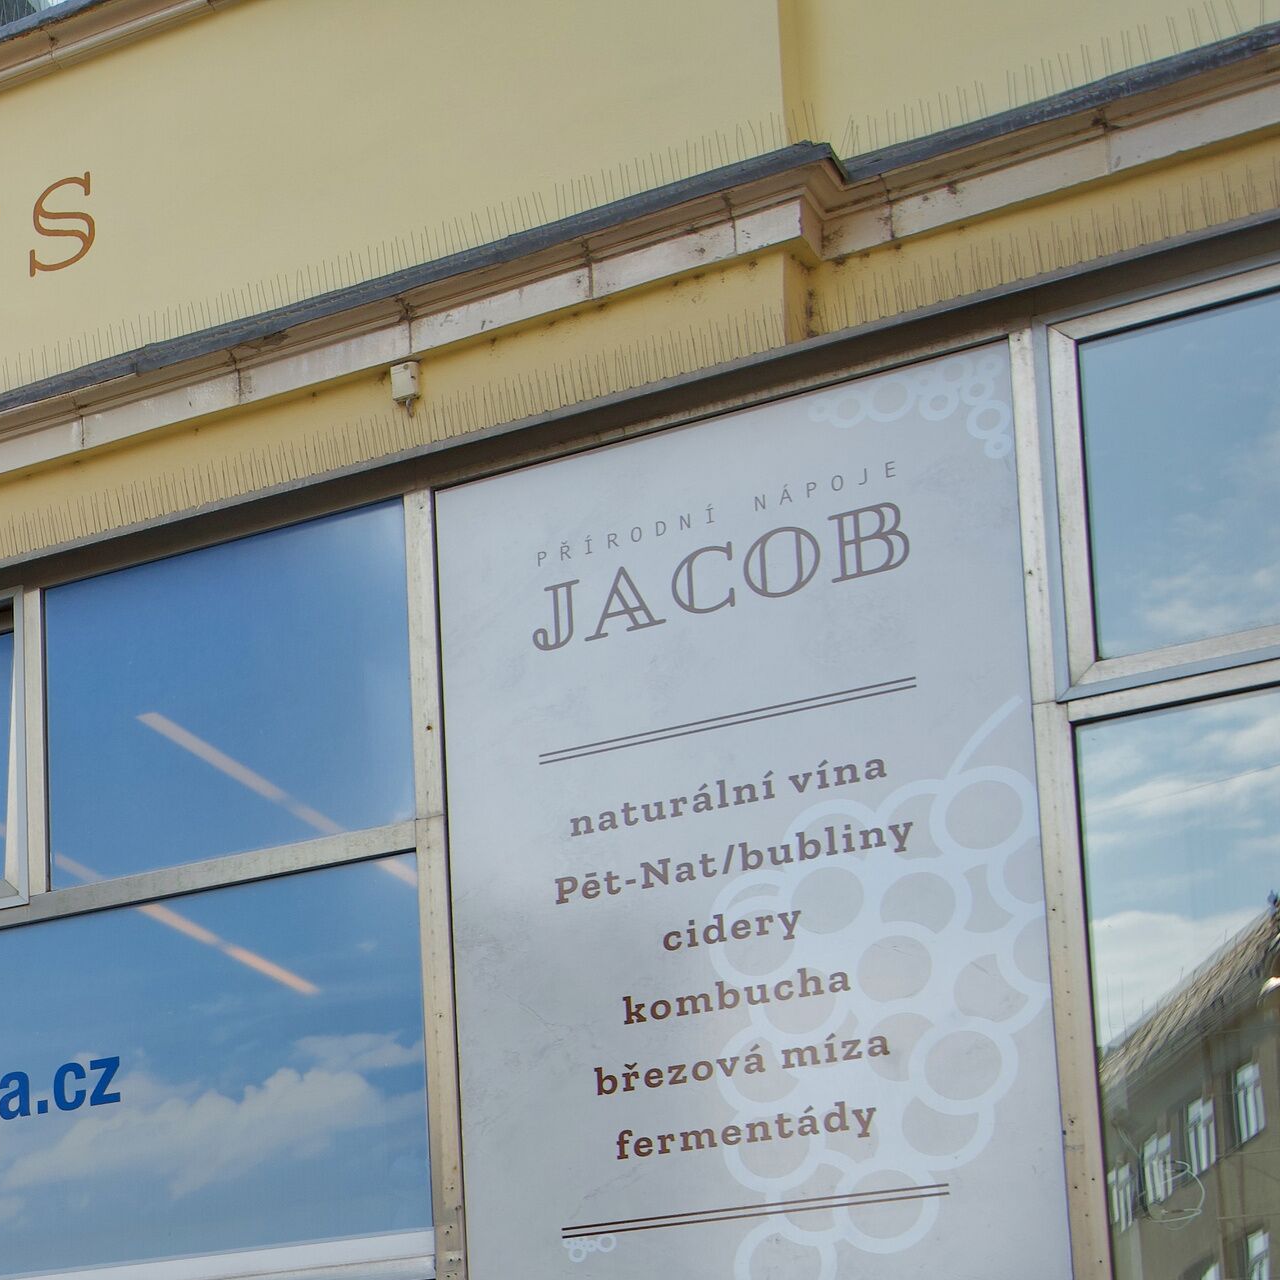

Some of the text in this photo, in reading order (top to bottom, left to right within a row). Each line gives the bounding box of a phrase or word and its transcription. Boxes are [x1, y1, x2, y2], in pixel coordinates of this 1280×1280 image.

[536, 461, 897, 567] PŘÍRODNÍ NÁPOJE
[532, 502, 910, 651] JACOB
[570, 757, 887, 837] naturální vína
[663, 910, 801, 951] cidery
[622, 967, 851, 1025] kombucha
[594, 1032, 890, 1095] březová míza
[616, 1101, 876, 1160] fermentády
